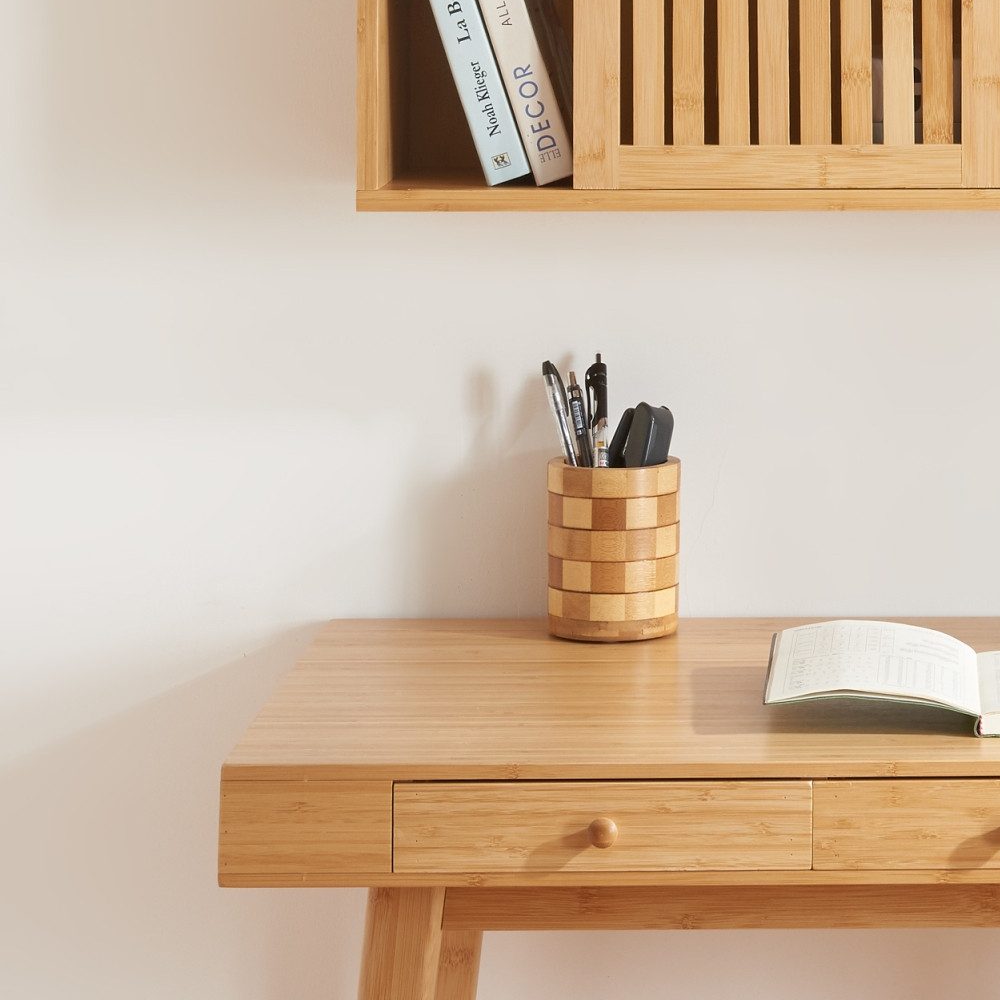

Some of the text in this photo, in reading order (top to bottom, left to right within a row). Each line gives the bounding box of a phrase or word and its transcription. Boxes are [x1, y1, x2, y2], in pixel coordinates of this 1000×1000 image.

[457, 18, 471, 43] La
[470, 61, 502, 138] Noah Klieger
[513, 63, 557, 152] DECOR
[539, 148, 562, 164] ELLE
